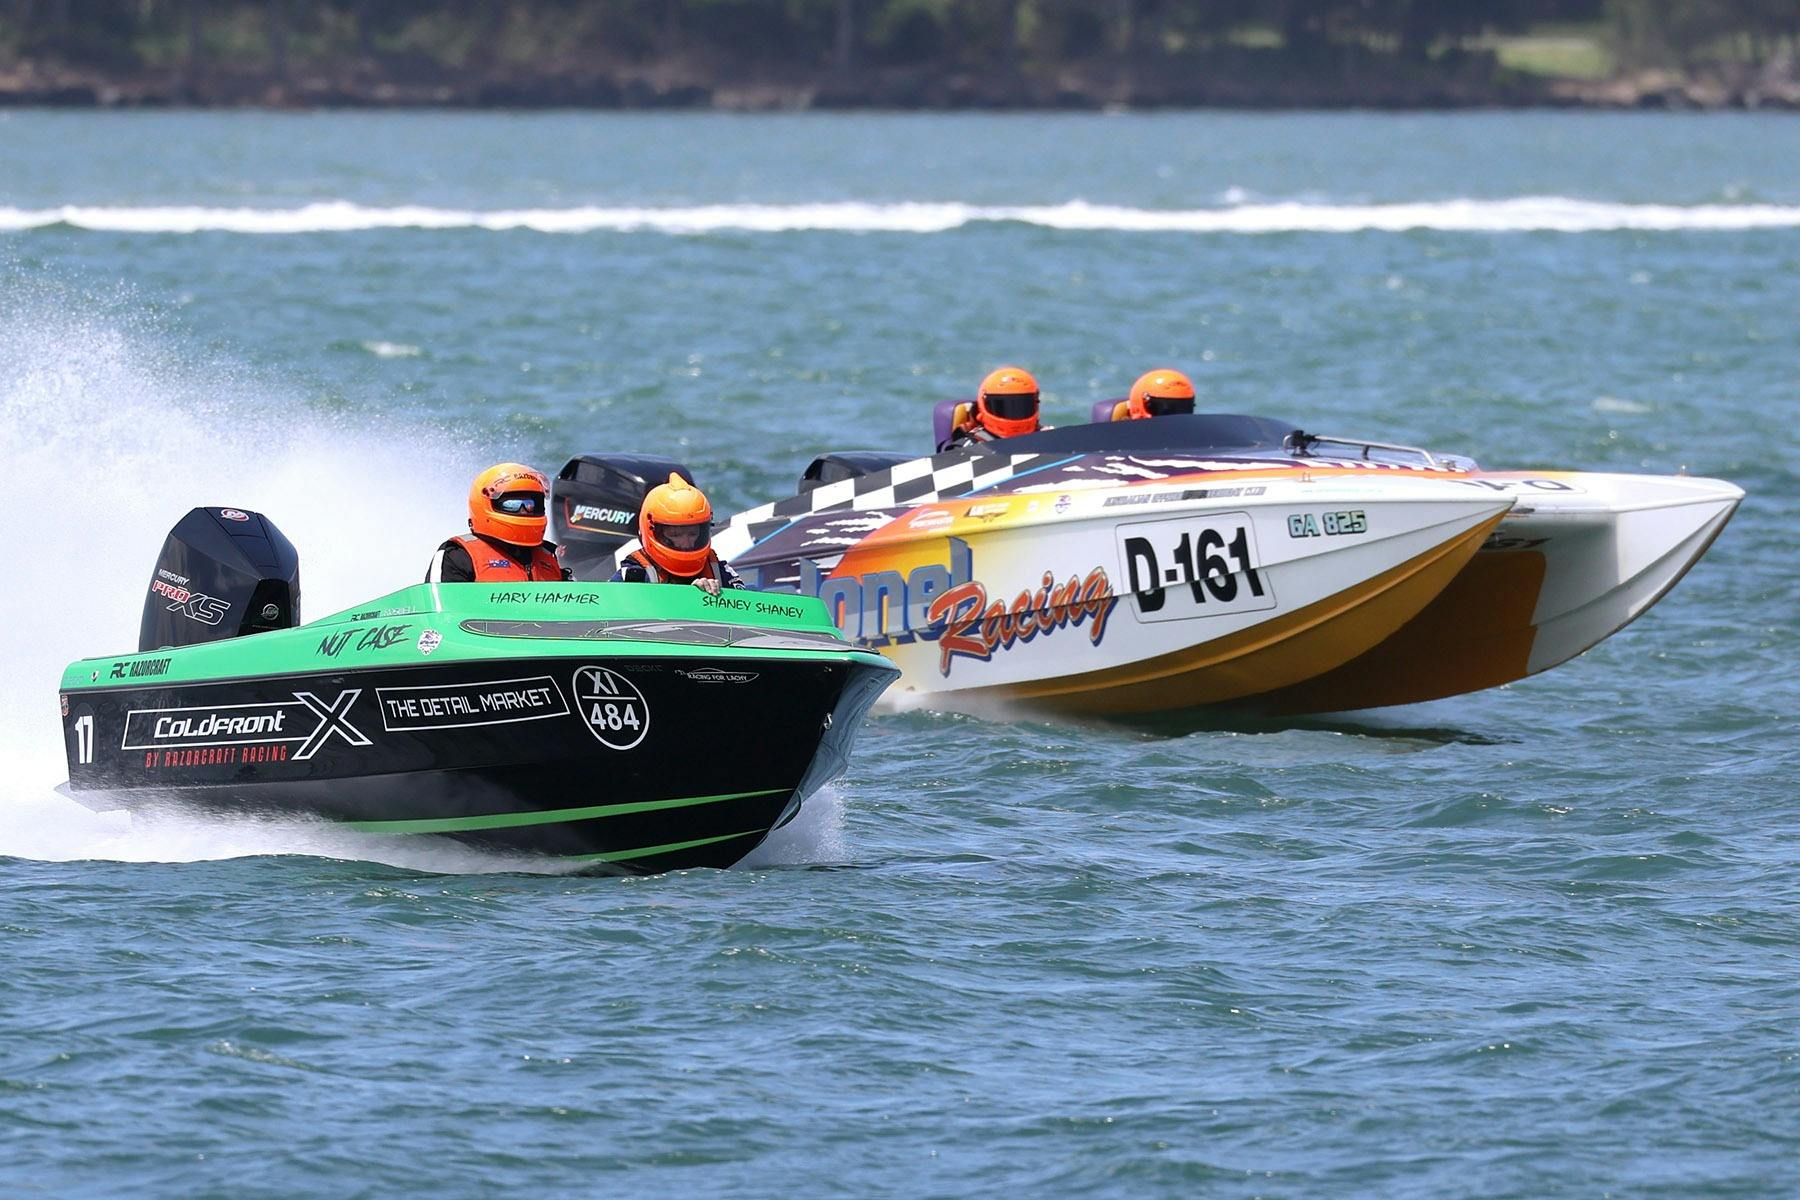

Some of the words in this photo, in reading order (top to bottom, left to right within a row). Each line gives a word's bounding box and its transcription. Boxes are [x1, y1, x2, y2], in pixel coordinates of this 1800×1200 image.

[571, 503, 636, 525] MERCURY
[1322, 510, 1367, 535] 825
[158, 568, 190, 586] MERCURY
[1124, 527, 1264, 613] D-161
[152, 580, 191, 604] PRO
[490, 592, 532, 605] HARY
[534, 593, 600, 606] HAMMER
[166, 592, 231, 625] XS
[702, 595, 751, 611] SHANEY
[755, 602, 804, 619] SHANEY
[928, 565, 1114, 678] Racing
[315, 628, 365, 659] NUT
[356, 623, 413, 652] CASE
[129, 658, 172, 677] RAZORCRAFT
[386, 699, 420, 718] THE
[422, 696, 479, 718] DETAIL
[478, 688, 552, 713] MARKET
[590, 702, 641, 731] 484
[74, 715, 94, 765] 17
[145, 751, 160, 768] BY
[164, 747, 236, 768] RAZORCRAFT
[241, 745, 287, 764] RACING
